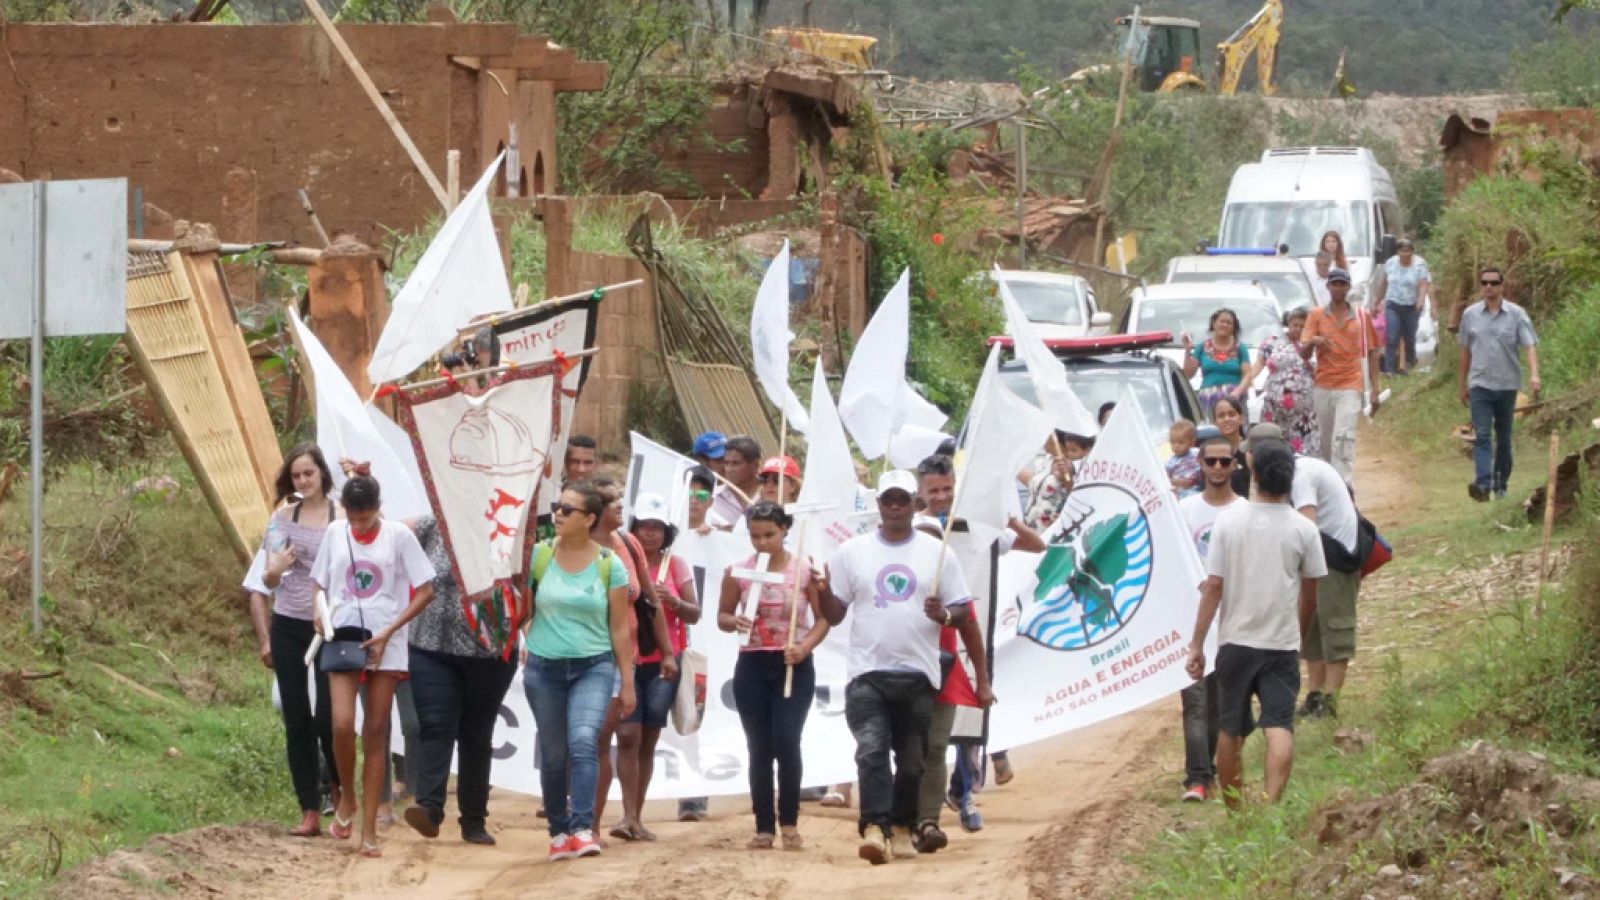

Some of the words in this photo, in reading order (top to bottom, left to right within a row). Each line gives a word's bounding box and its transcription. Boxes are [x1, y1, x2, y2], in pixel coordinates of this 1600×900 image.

[1091, 636, 1131, 667] Brasil
[1094, 669, 1108, 684] E
[1110, 629, 1182, 677] ENERGIA
[1101, 645, 1191, 698] MERCADORIA
